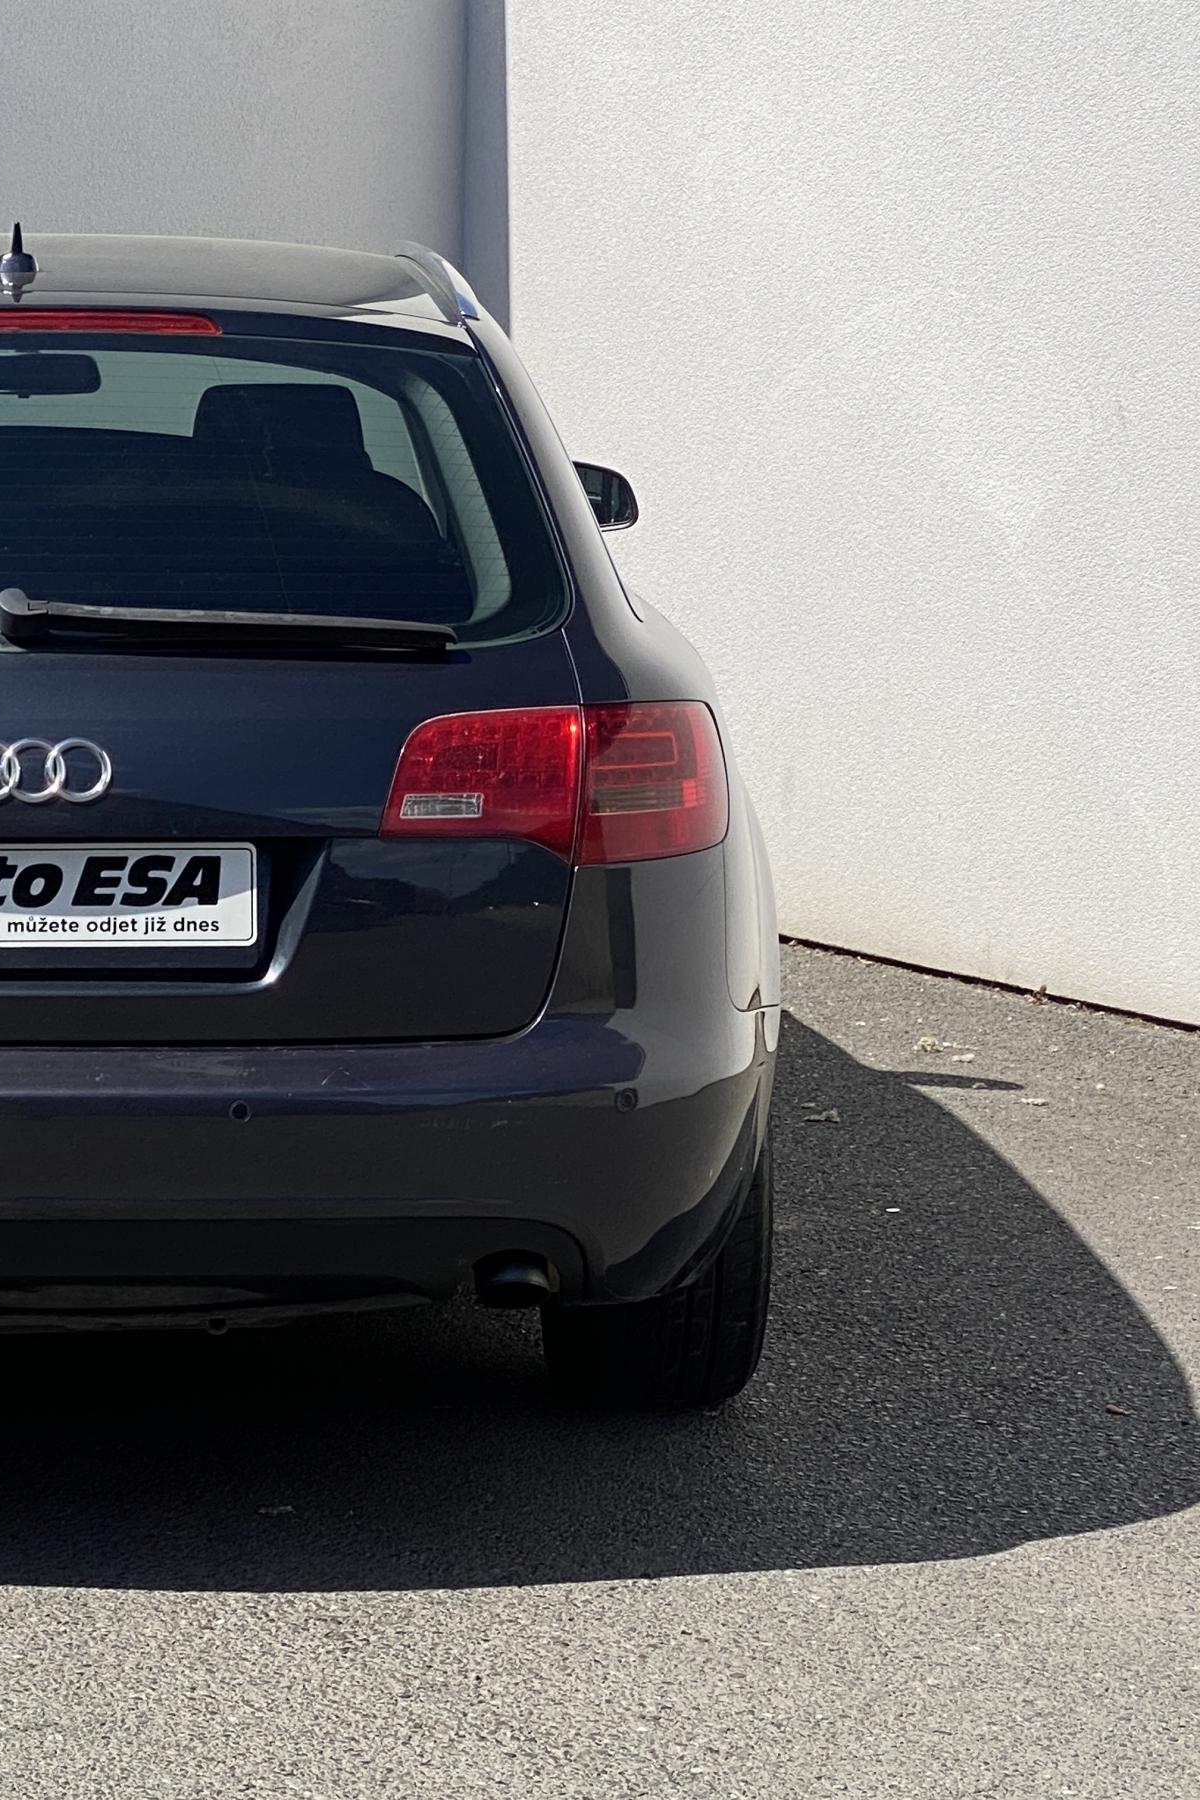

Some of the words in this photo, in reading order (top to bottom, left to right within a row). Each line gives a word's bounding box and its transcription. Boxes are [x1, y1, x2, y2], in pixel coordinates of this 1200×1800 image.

[71, 855, 222, 907] ESA
[7, 916, 79, 933] můžete
[86, 917, 138, 935] odjet
[143, 916, 167, 935] již
[173, 917, 220, 933] dnes
